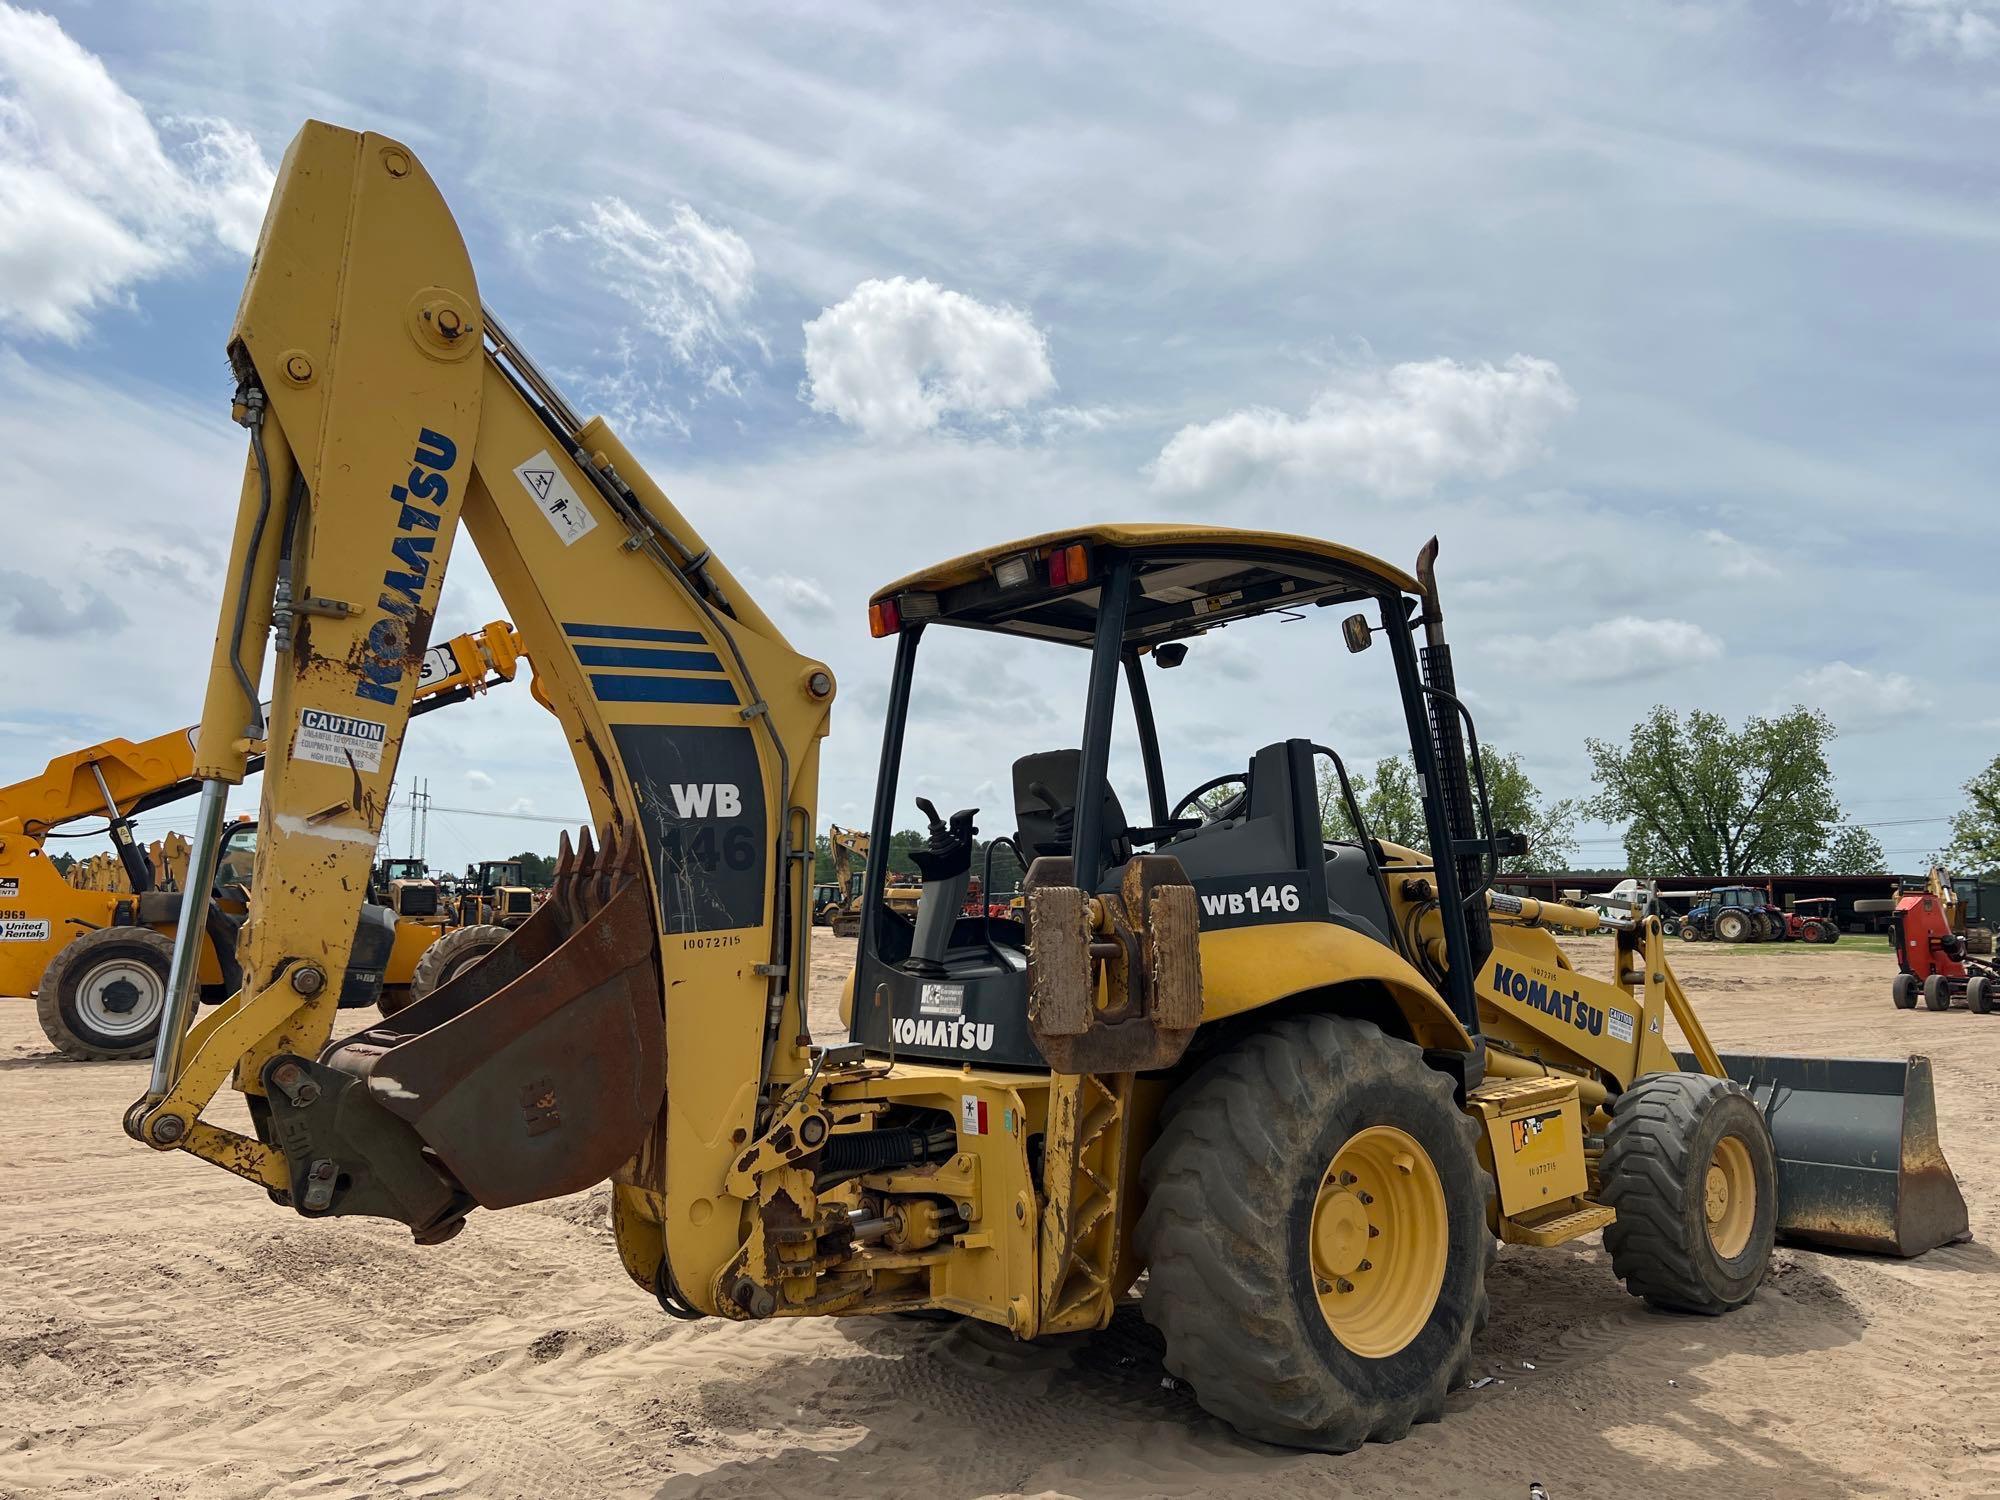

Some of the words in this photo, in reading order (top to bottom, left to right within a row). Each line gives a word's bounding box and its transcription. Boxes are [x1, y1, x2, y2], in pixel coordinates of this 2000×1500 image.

[355, 427, 457, 706] KOMATSU
[306, 712, 381, 740] CAUTION
[301, 739, 332, 752] EQUIPMENT
[333, 735, 340, 744] TO
[341, 736, 365, 748] OPERATE
[366, 741, 378, 750] THIS
[310, 752, 324, 761] HIGH
[325, 755, 348, 766] VOLTAGE
[669, 783, 742, 819] WB
[660, 826, 756, 874] 146
[1200, 884, 1300, 916] WB146
[6, 922, 43, 930] United
[683, 935, 741, 951] 10072715
[1493, 962, 1604, 1037] KOMATSU
[1610, 1008, 1633, 1026] CAUTION
[888, 1014, 995, 1051] KOMATSU
